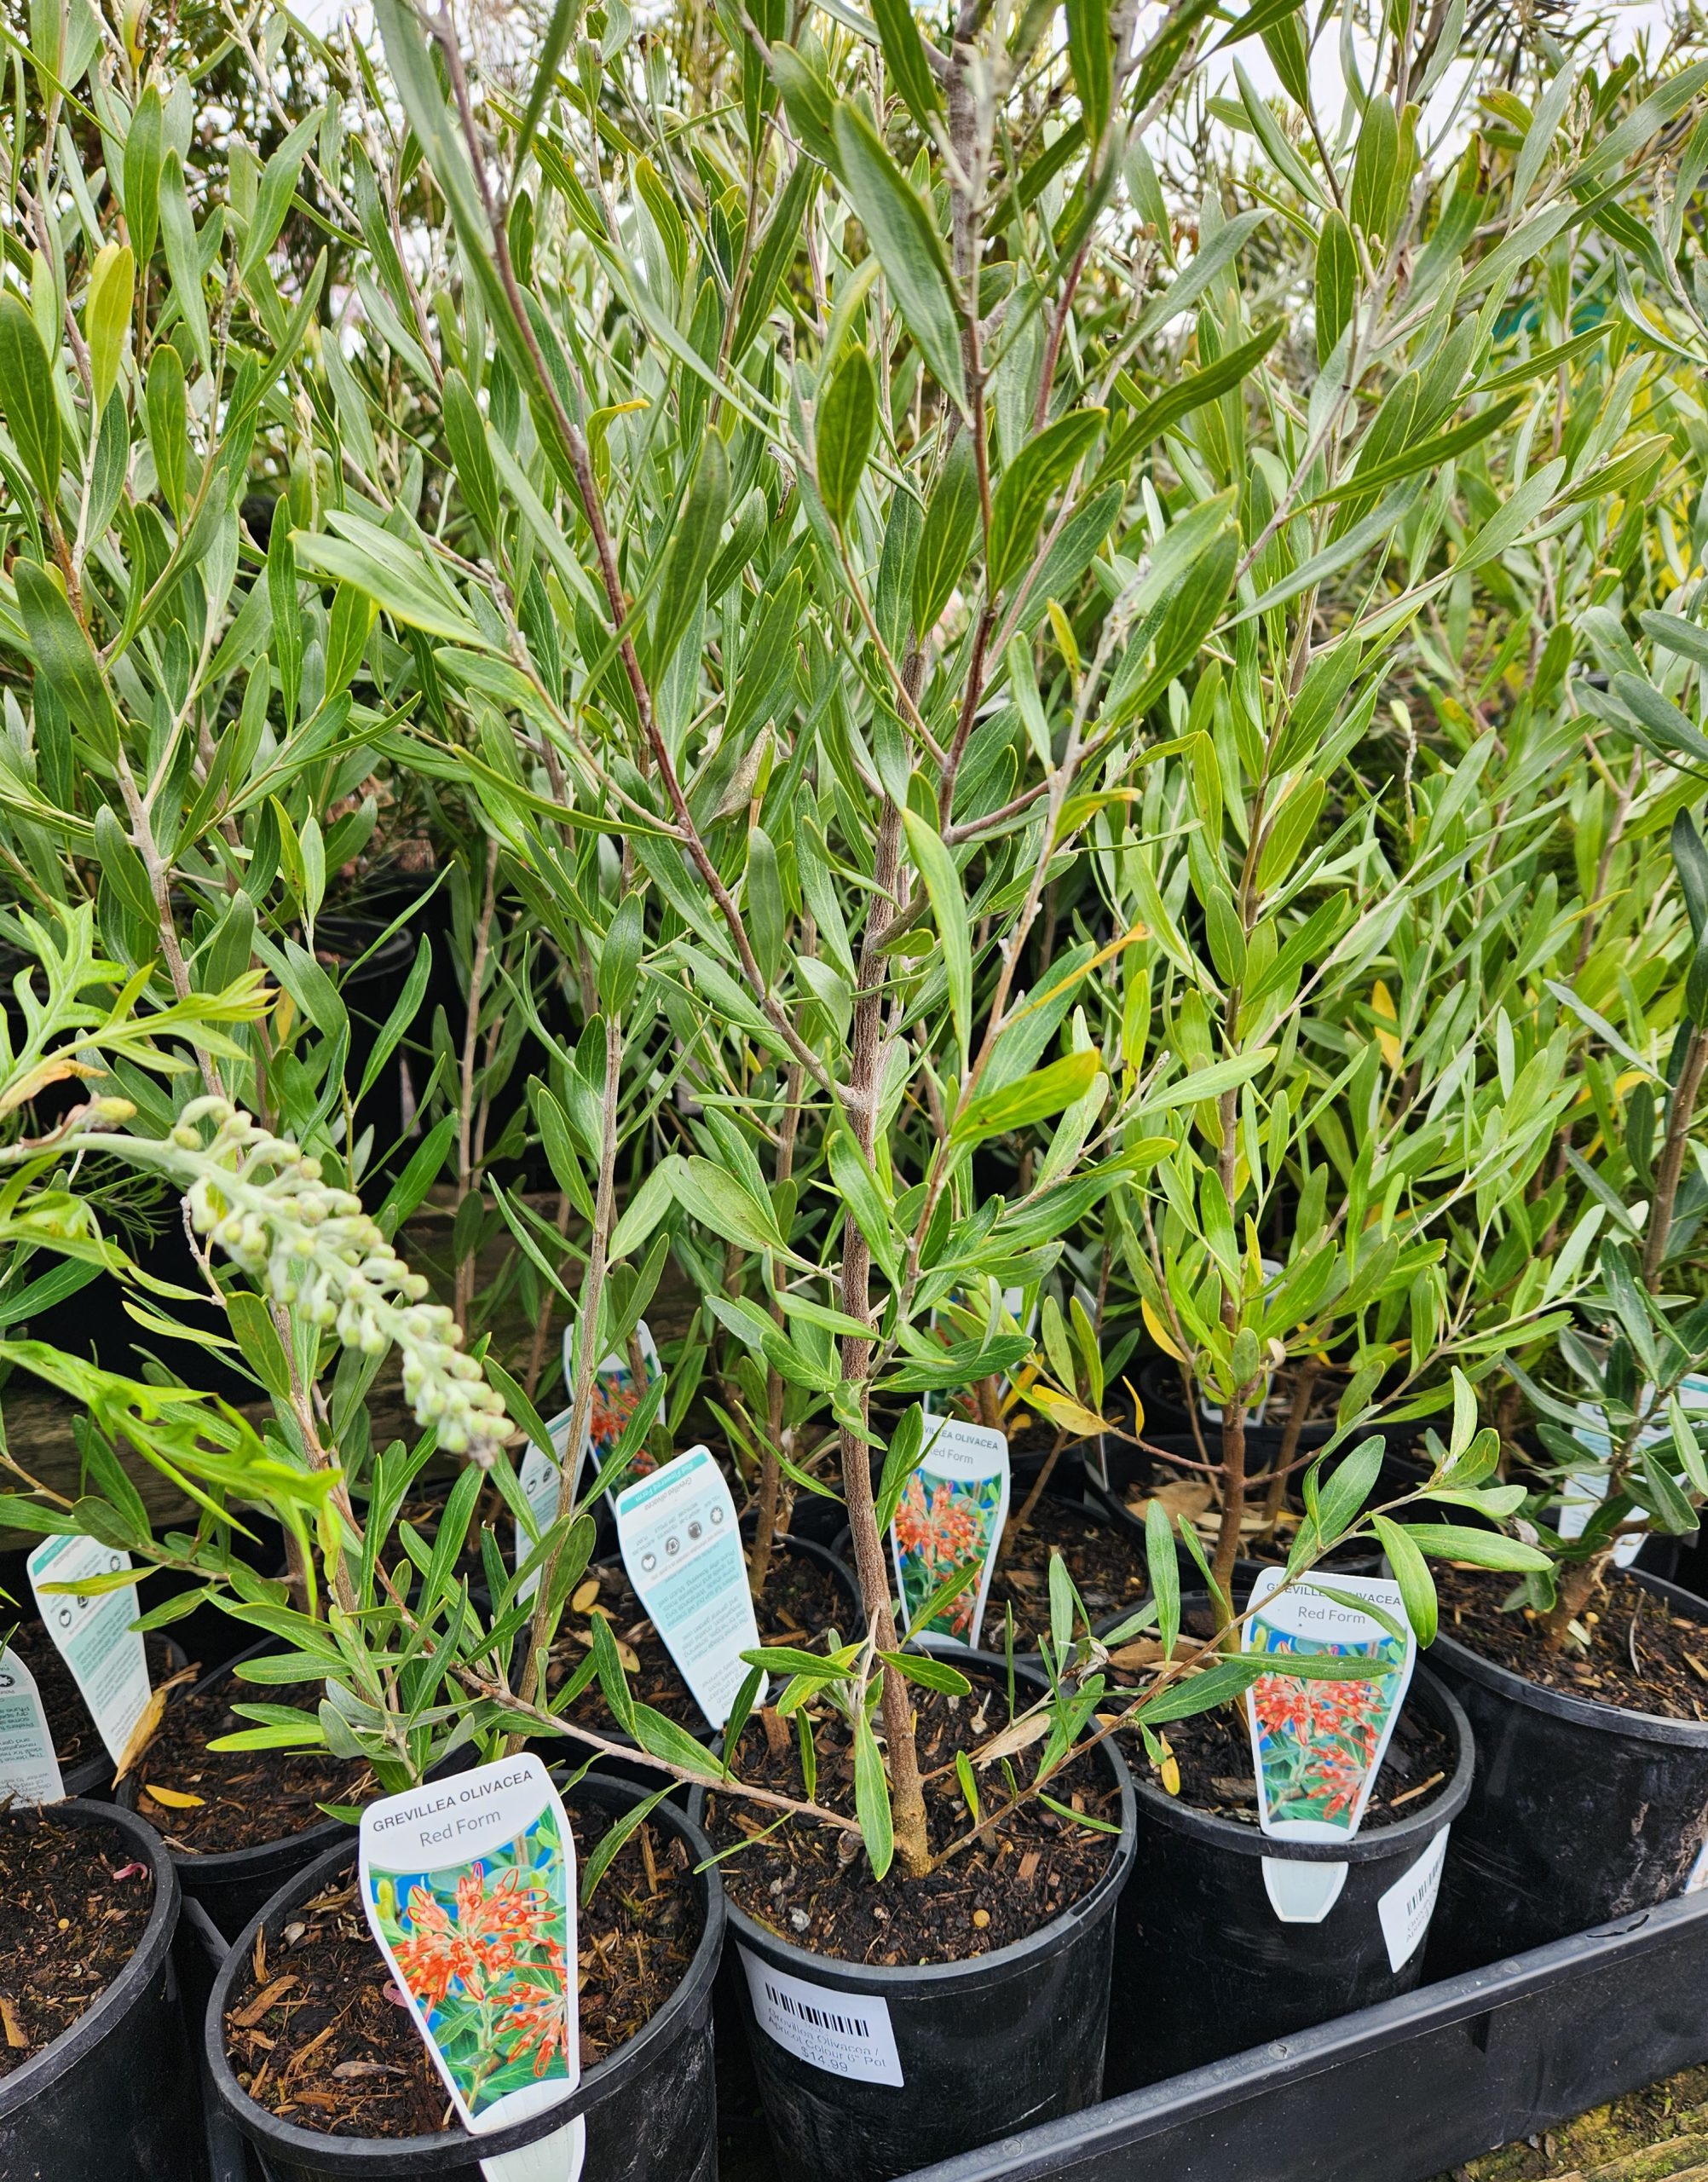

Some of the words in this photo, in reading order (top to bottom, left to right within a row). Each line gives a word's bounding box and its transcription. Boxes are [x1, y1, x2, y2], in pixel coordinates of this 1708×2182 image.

[955, 1433, 998, 1450] OLIVACEA
[948, 1449, 973, 1464] Form
[1298, 1606, 1324, 1619] Red
[1329, 1610, 1365, 1624] Form
[373, 1797, 456, 1832] GREVILLEA
[459, 1770, 533, 1803] OLIVACEA
[419, 1823, 453, 1847] Red
[456, 1811, 501, 1834] Form
[769, 2016, 803, 2044] Apricot
[805, 2039, 842, 2058] Colour
[865, 2057, 886, 2067] Pot
[817, 2035, 870, 2055] Olivacea
[801, 2046, 848, 2072] $14.99
